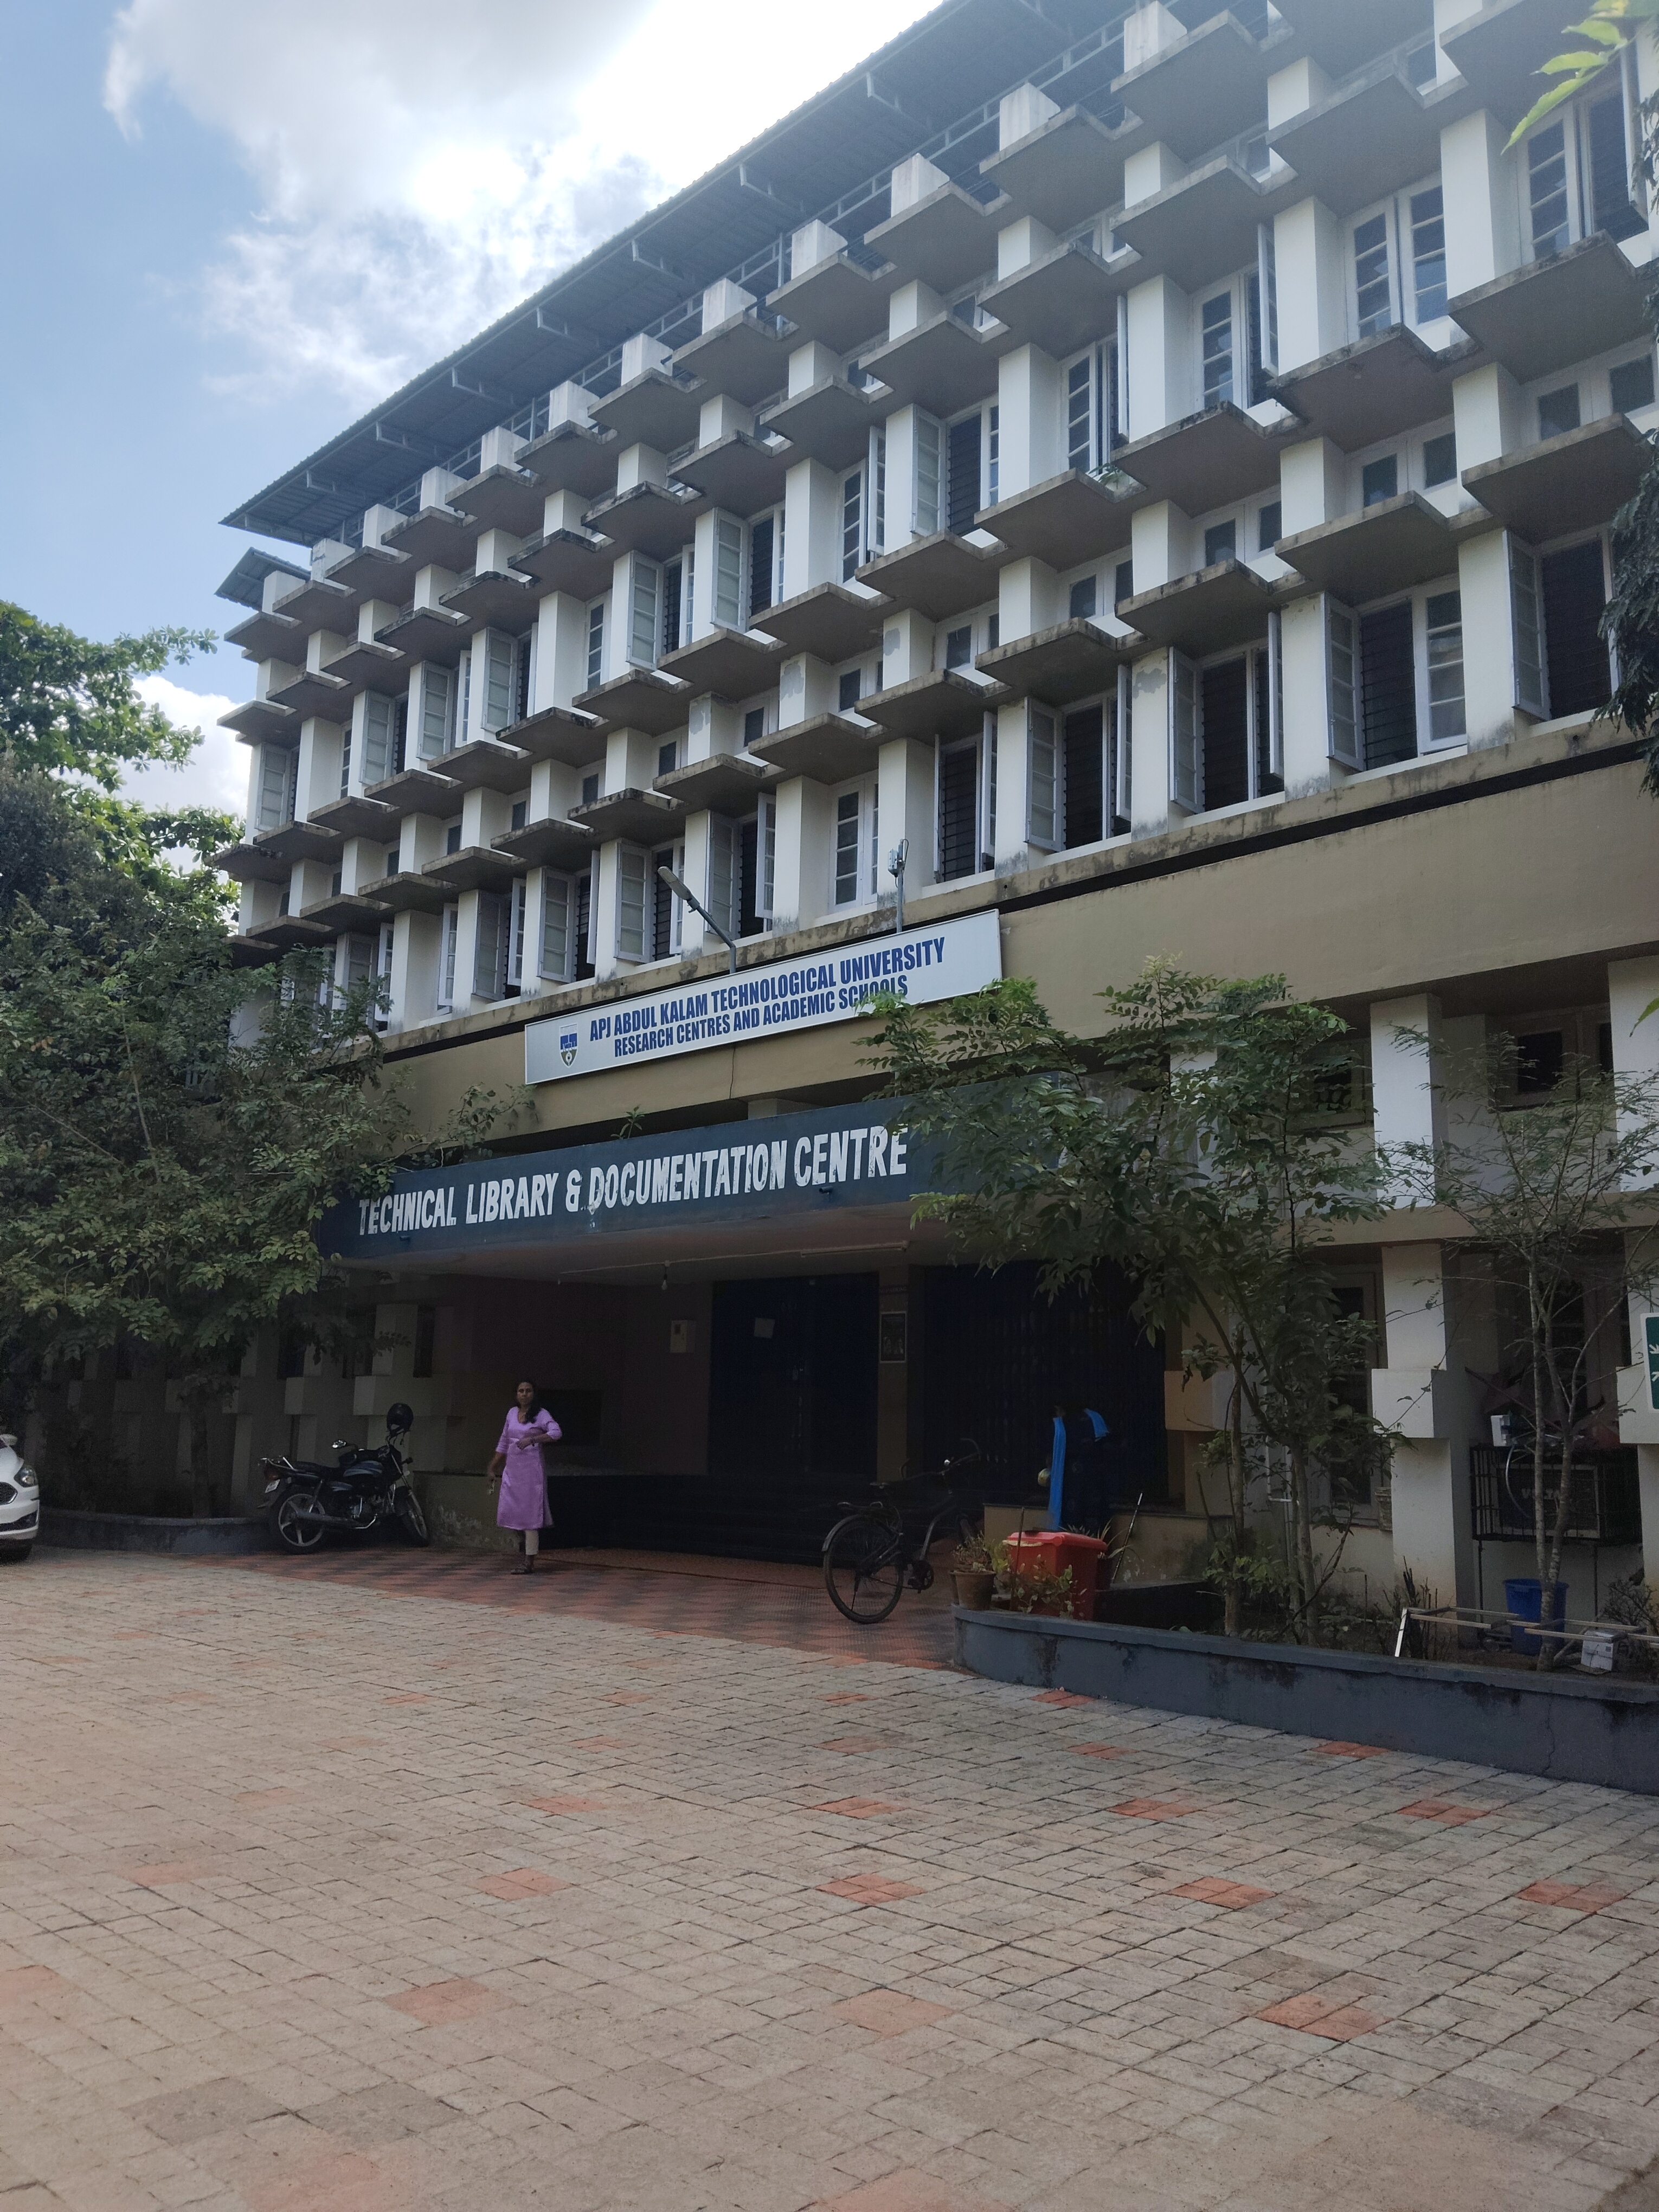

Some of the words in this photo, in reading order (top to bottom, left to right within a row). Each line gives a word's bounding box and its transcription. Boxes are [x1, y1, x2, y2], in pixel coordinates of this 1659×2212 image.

[590, 1017, 611, 1041] APJ
[614, 1006, 657, 1036] ABDUL
[660, 993, 708, 1025] KALAM
[711, 963, 837, 1013] TECHNOLOGICAL
[840, 937, 945, 985] UNIVERSITY
[614, 1027, 673, 1057] RESEARCH
[677, 1014, 730, 1044] CENTRES
[733, 1008, 760, 1032] AND
[763, 991, 835, 1026] ACADEMIC
[359, 1186, 456, 1236] TECHNICAL
[465, 1173, 559, 1224] LIBRARY
[565, 1169, 582, 1212] &
[588, 1140, 787, 1210] DOCUMENTATION
[794, 1123, 909, 1187] CENTRE
